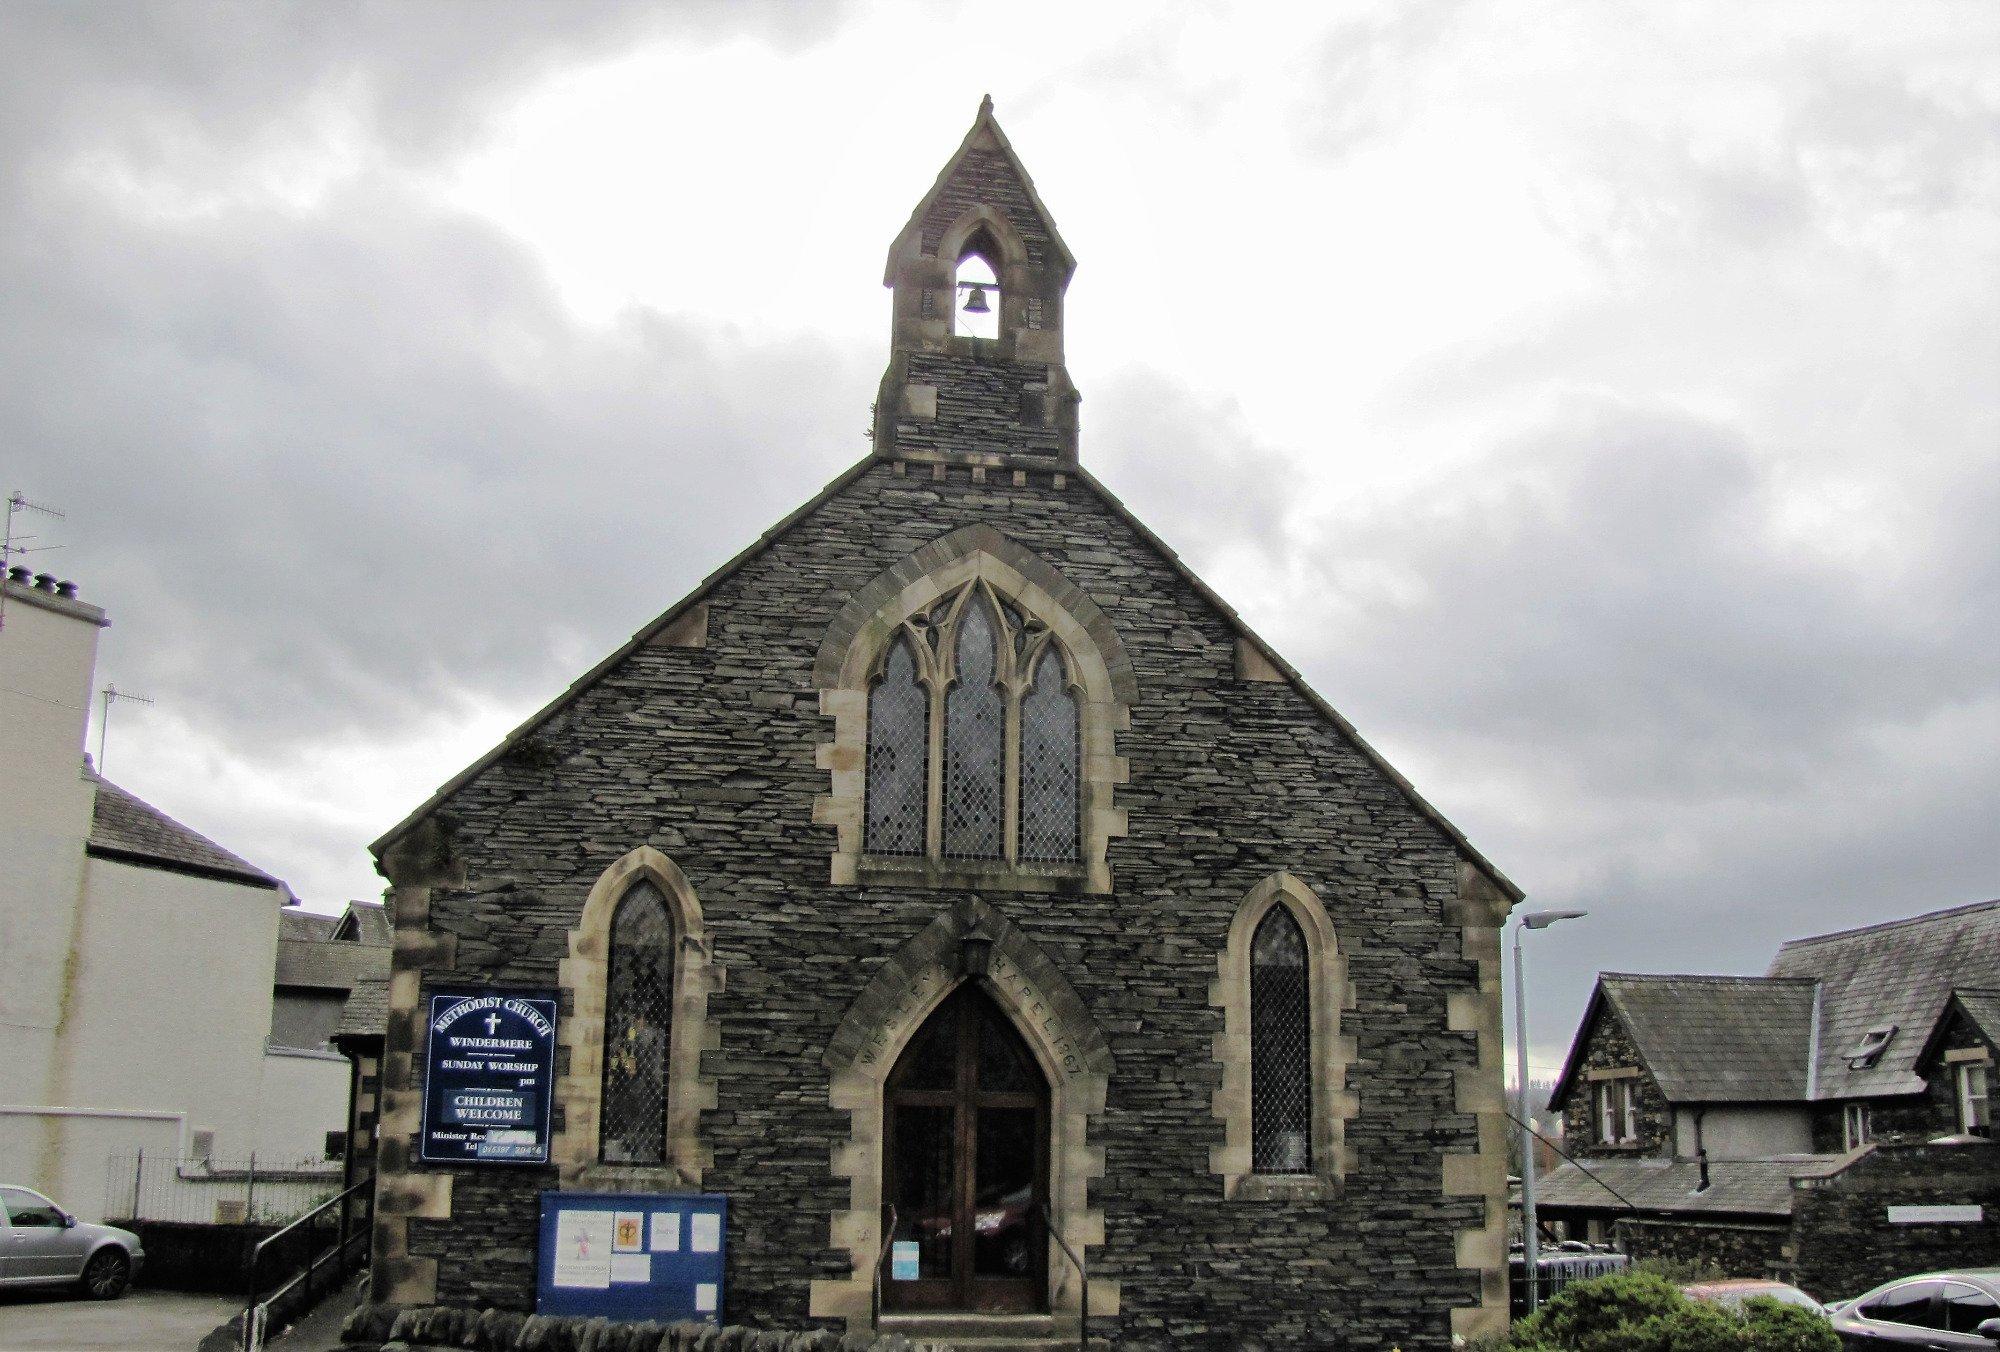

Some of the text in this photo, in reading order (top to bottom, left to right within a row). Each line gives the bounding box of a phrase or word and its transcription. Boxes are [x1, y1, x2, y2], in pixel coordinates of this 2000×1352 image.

[435, 997, 552, 1037] METHODIST CHURCH
[449, 1036, 533, 1049] WINDERMERE
[1053, 1036, 1082, 1073] 1867
[441, 1059, 539, 1072] SUNDAY WORSHIP
[519, 1078, 536, 1087] pm
[454, 1095, 524, 1107] CHILDREN
[454, 1108, 522, 1120] WELCOME
[432, 1131, 468, 1141] Minister
[464, 1142, 478, 1150] Tel
